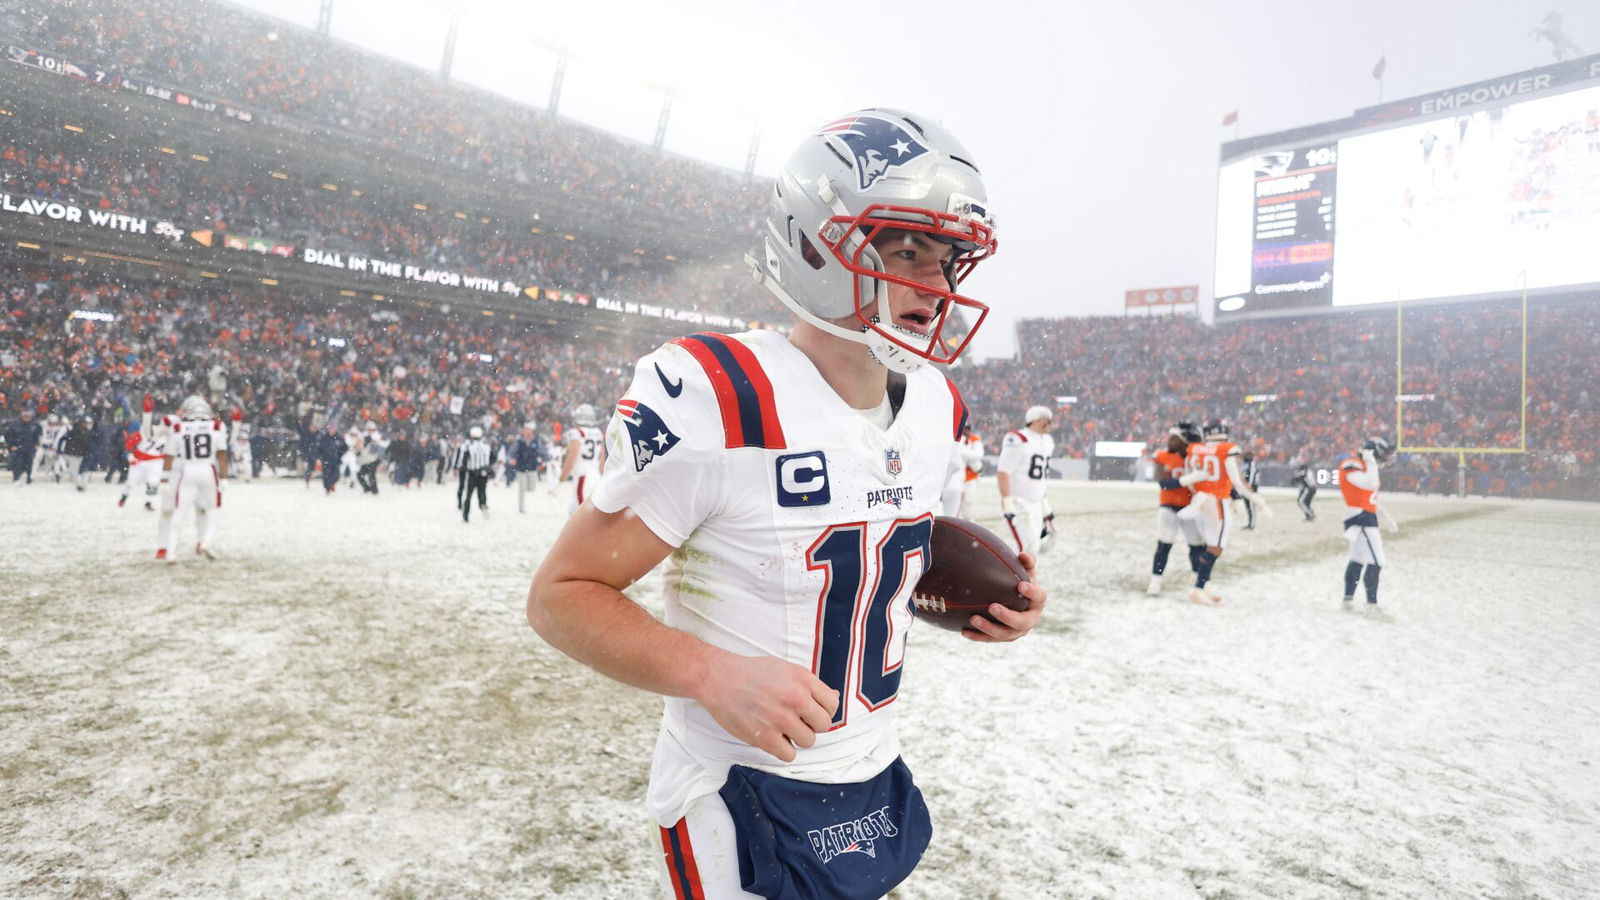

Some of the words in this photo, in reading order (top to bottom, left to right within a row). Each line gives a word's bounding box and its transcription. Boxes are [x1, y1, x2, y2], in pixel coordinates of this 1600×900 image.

[36, 55, 55, 69] 10
[1421, 74, 1551, 115] EMPOWER
[88, 209, 147, 234] WITH
[304, 248, 344, 268] DIAL
[349, 256, 367, 271] IN
[370, 259, 401, 277] THE
[405, 266, 460, 287] FLAVOR
[463, 275, 499, 293] WITH
[596, 297, 623, 312] DIAL
[640, 304, 663, 317] THE
[182, 433, 212, 460] 18
[781, 455, 825, 493] C
[888, 460, 901, 473] NFL
[867, 486, 913, 508] PATRIOTS
[805, 512, 934, 732] 10
[807, 805, 899, 864] PATRIOTS
